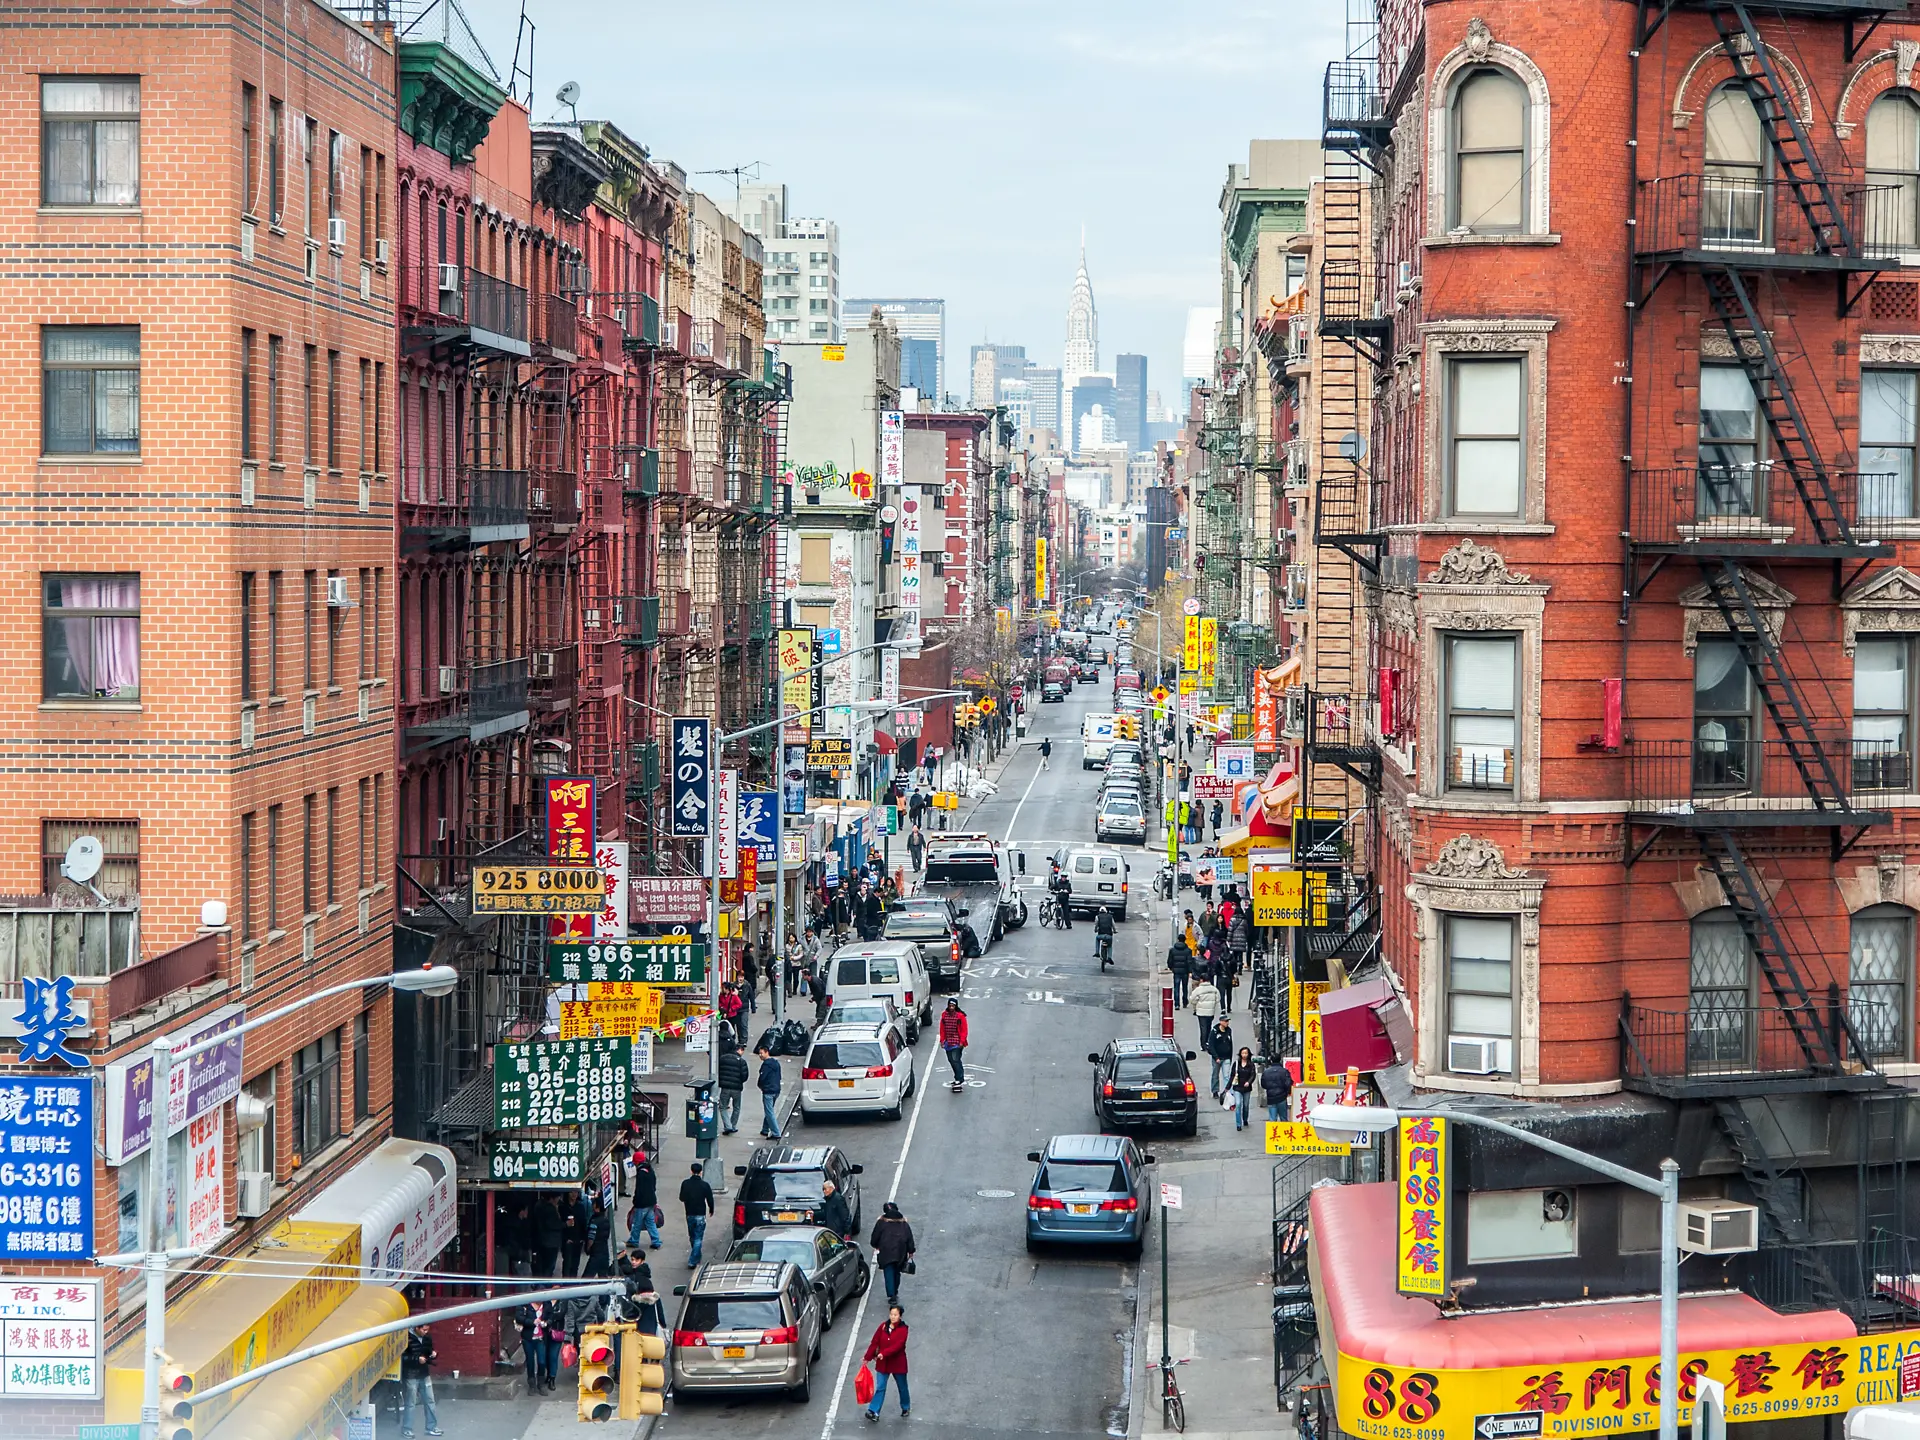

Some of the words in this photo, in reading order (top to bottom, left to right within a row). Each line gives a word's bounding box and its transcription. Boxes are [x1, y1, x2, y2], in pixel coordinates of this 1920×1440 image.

[895, 726, 917, 737] KTV
[482, 871, 528, 890] 925
[538, 871, 598, 890] 8000
[632, 880, 702, 892] 中日職業介紹所
[477, 894, 601, 911] 中國職業介紹所
[562, 953, 581, 962] 212
[588, 945, 691, 963] 966-1111
[562, 964, 691, 981] 職業介紹所
[563, 1002, 593, 1019] 星星
[639, 1017, 657, 1025] 1999
[517, 1052, 611, 1073] 職業介紹所
[501, 1081, 521, 1093] 212
[527, 1066, 625, 1090] 925-8888
[34, 1087, 80, 1106] 肝膽
[501, 1099, 521, 1110] 212
[530, 1084, 625, 1107] 227-8888
[35, 1107, 81, 1127] 中心
[501, 1116, 521, 1128] 212
[527, 1101, 626, 1125] 226-8888
[11, 1136, 71, 1154] 醫學博士
[1291, 1145, 1343, 1153] 347-684-0321
[493, 1156, 580, 1177] 964-9696
[7, 1232, 83, 1252] 無保險者優惠
[11, 1286, 88, 1303] 商場
[33, 1306, 66, 1316] INC.
[9, 1327, 90, 1349] 鴻發服務社
[11, 1363, 91, 1386] 成功集團電信
[1362, 1368, 1441, 1424] 88
[1485, 1422, 1504, 1433] ONE
[1513, 1419, 1535, 1431] WAY
[1553, 1412, 1623, 1432] DIVISION
[1632, 1412, 1653, 1427] ST.
[81, 1426, 129, 1439] DIVISION
